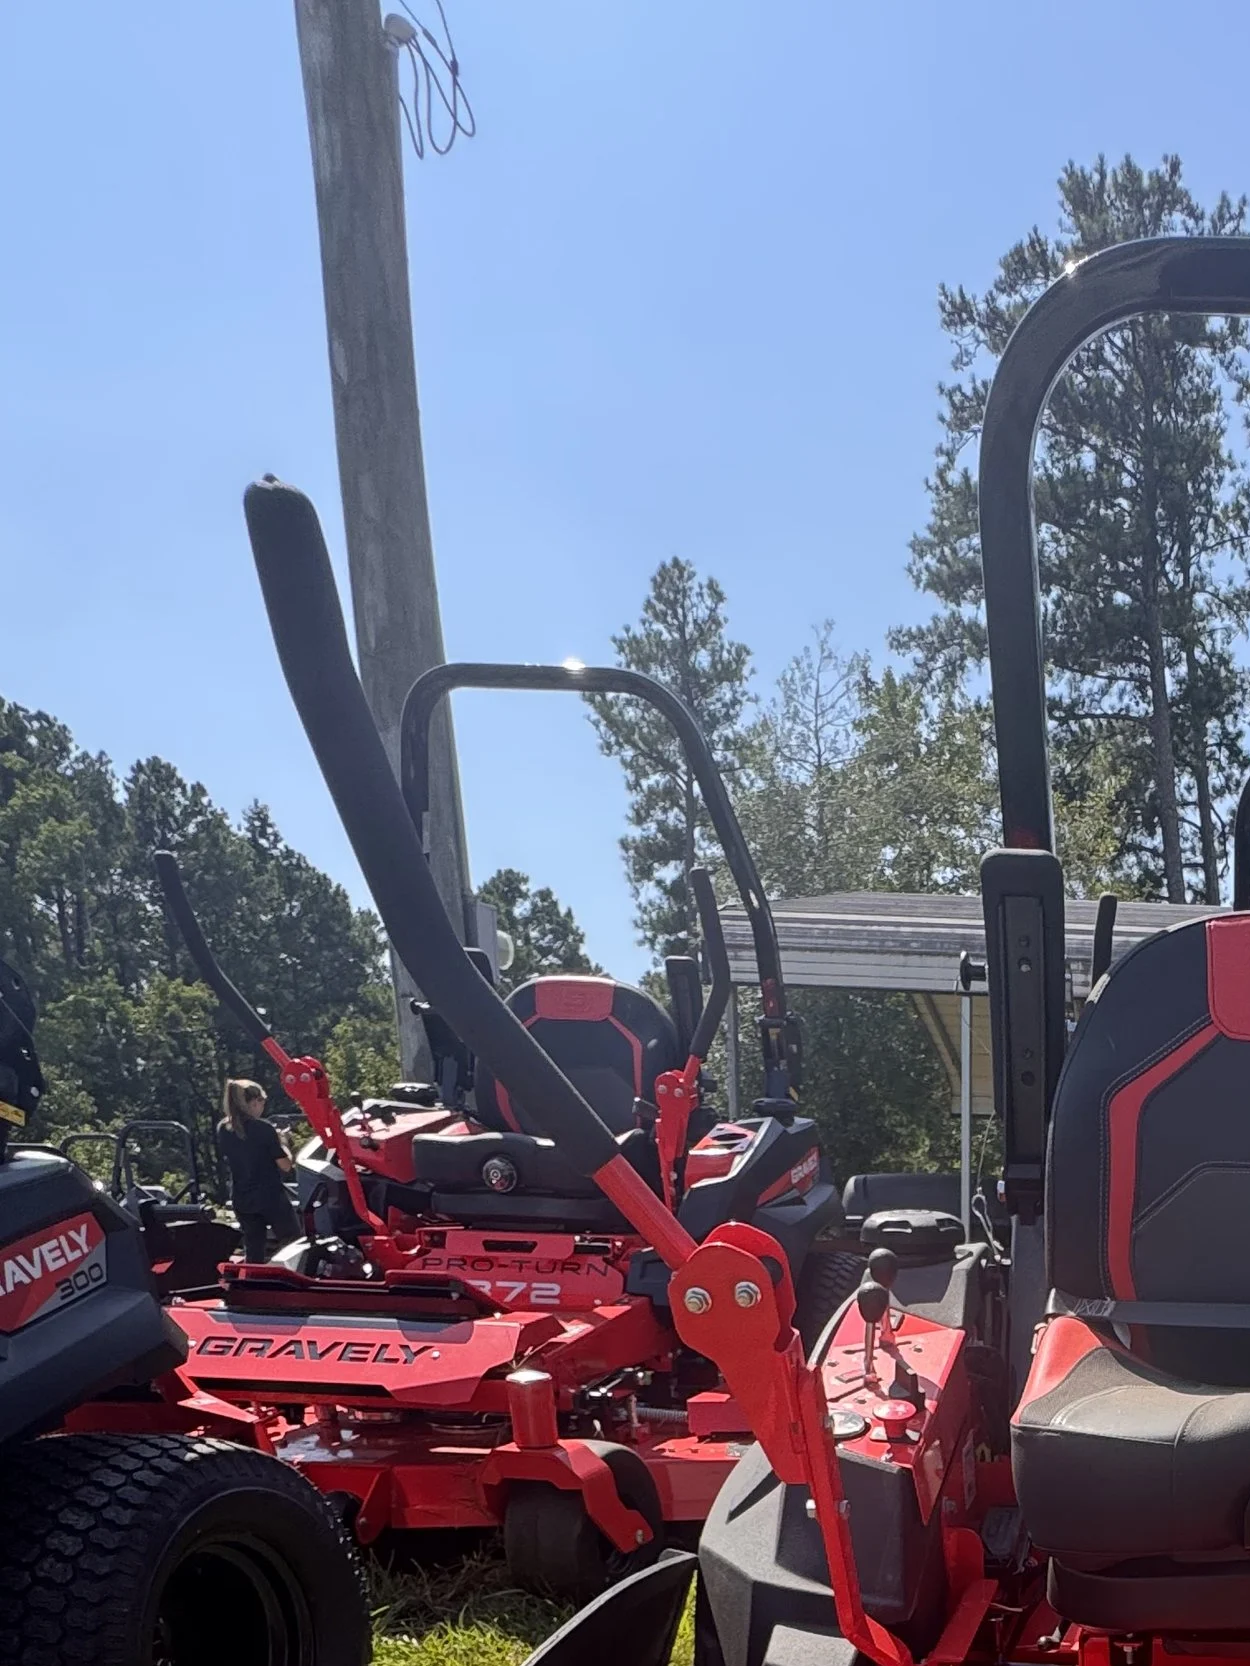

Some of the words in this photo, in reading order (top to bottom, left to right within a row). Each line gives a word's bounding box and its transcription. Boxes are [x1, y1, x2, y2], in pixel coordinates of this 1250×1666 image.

[0, 1223, 89, 1297] AVELY
[421, 1257, 609, 1277] PRO-TURN
[56, 1262, 103, 1300] 300
[196, 1336, 434, 1365] GRAVELY
